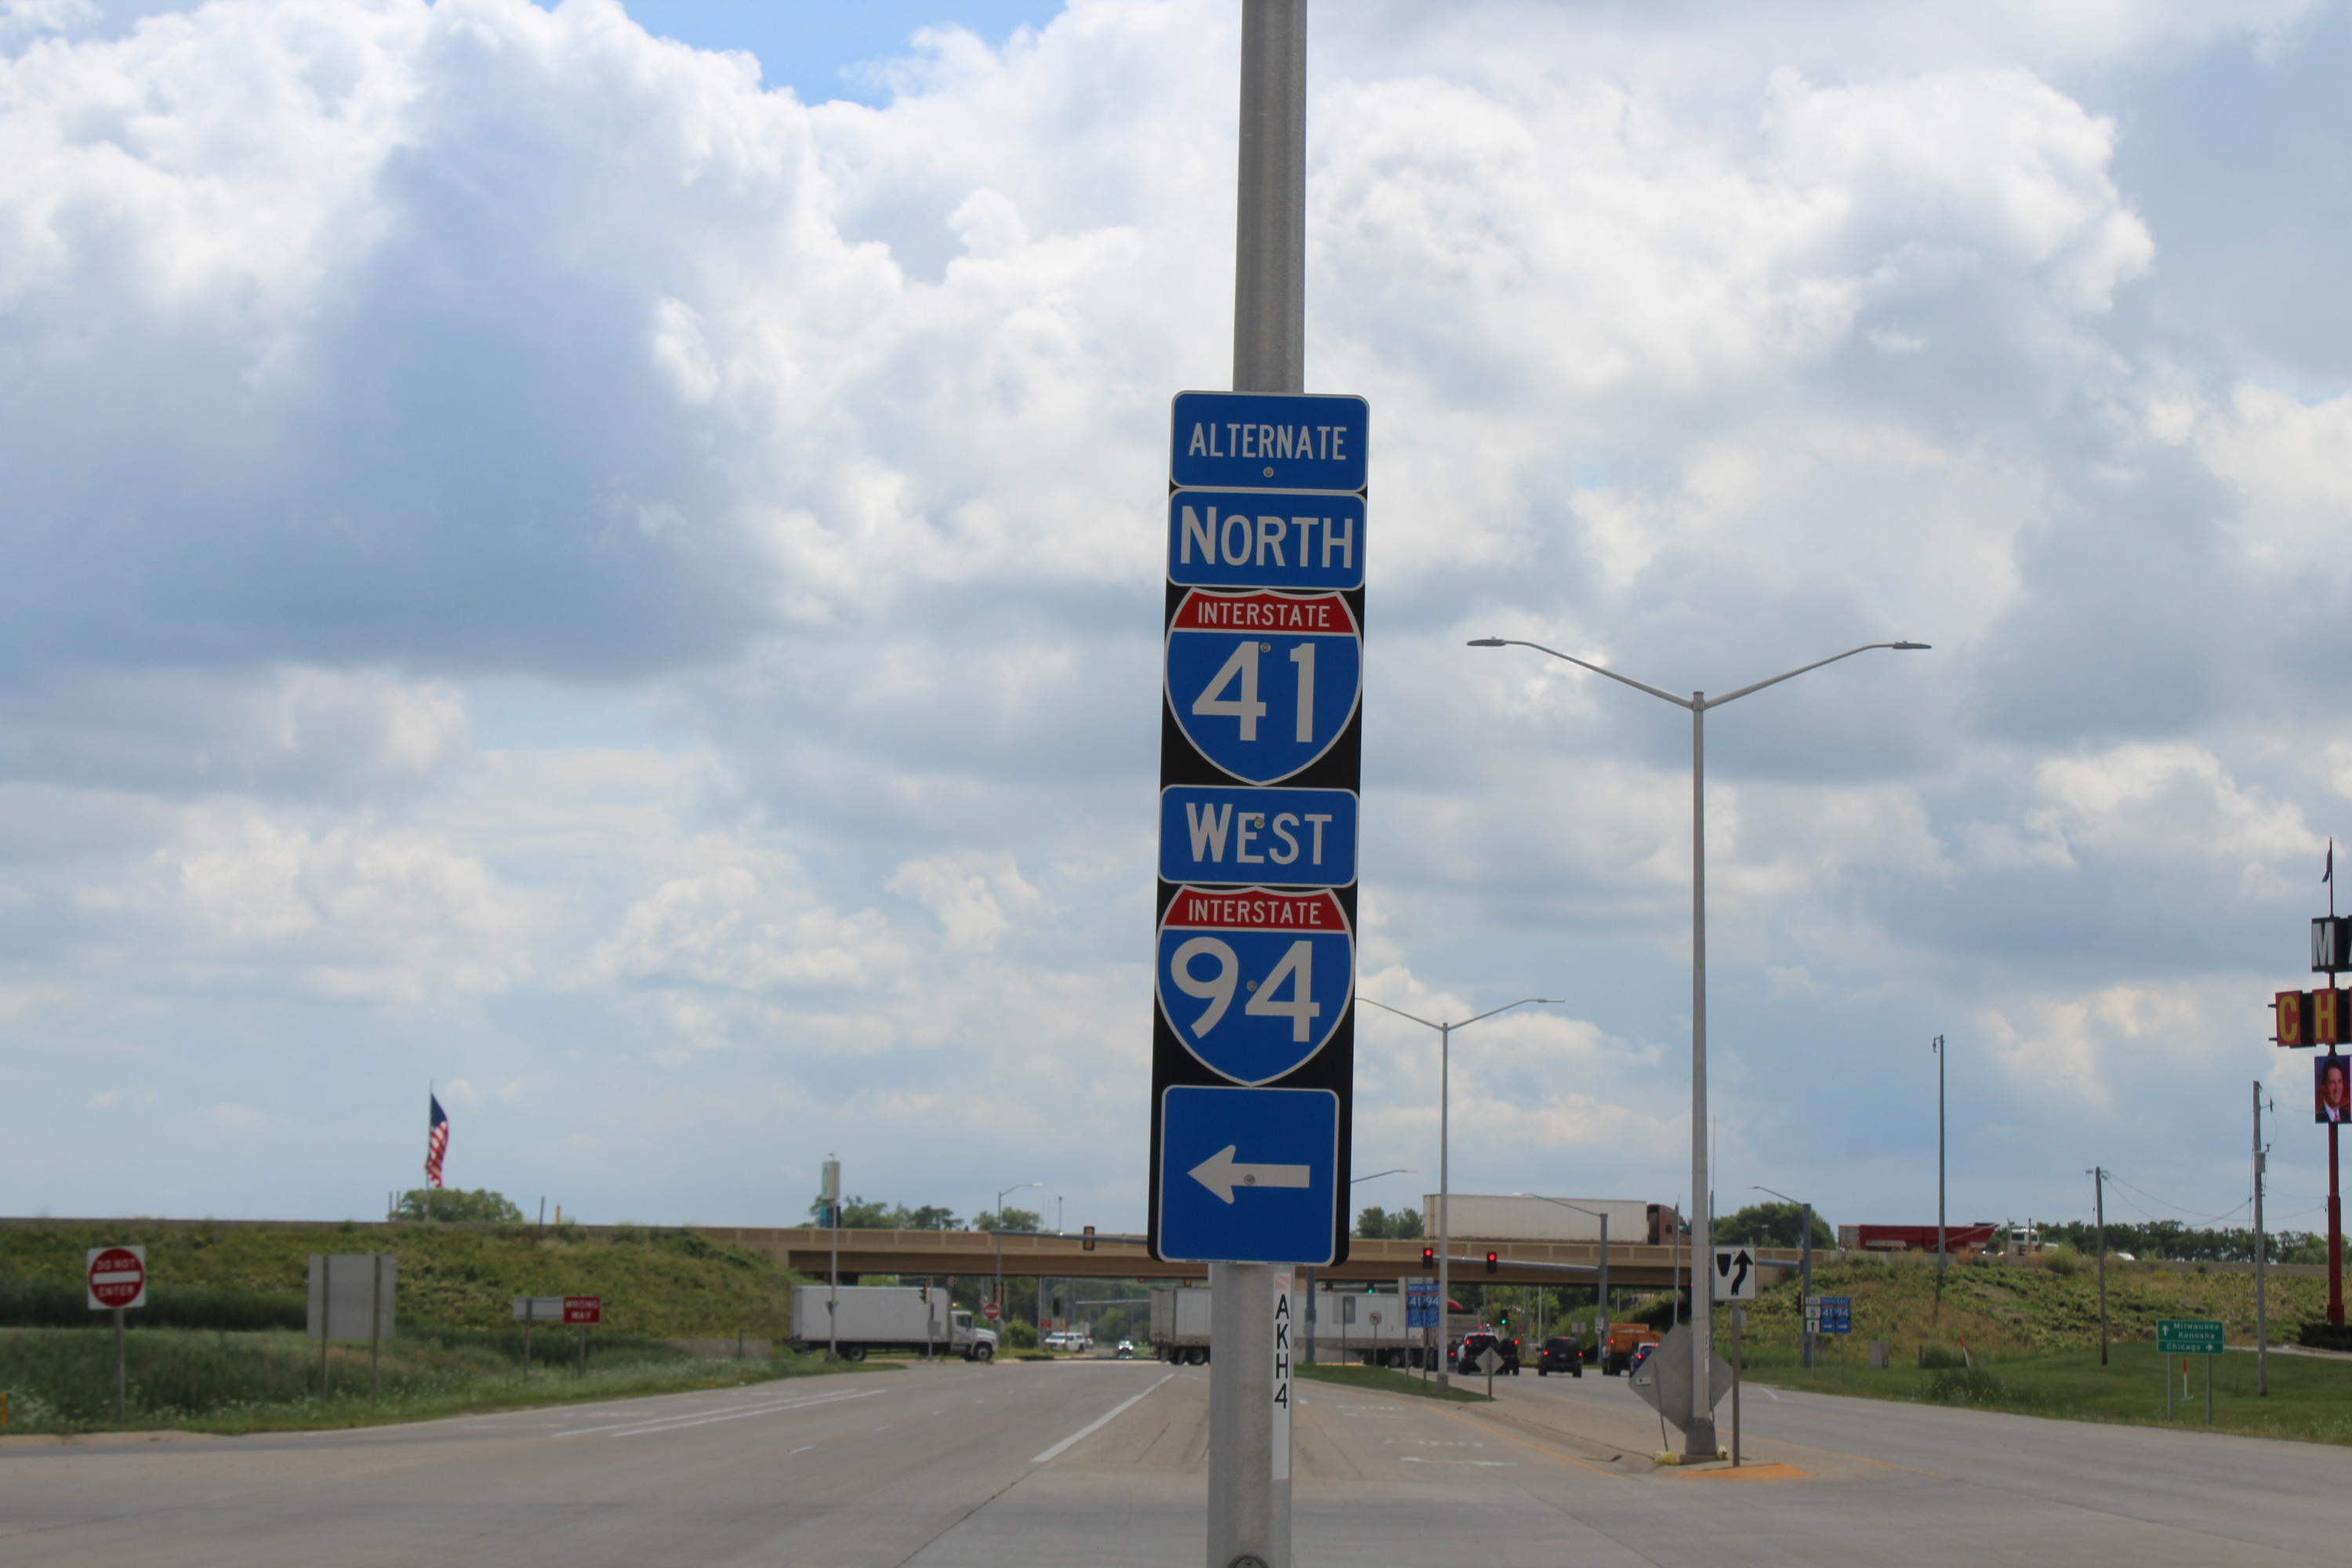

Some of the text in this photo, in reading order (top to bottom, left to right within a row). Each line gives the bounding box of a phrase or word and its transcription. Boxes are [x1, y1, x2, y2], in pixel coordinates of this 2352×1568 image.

[1189, 423, 1348, 461] ALTERNATE
[1180, 506, 1353, 568] NORTH
[1197, 601, 1330, 627] INTERSTATE
[1192, 641, 1316, 742] 41
[1185, 802, 1333, 866] WEST
[1189, 898, 1322, 925] INTERSTATE
[2312, 921, 2352, 967] M
[1171, 936, 1320, 1043] 94
[96, 1258, 136, 1270] DO NOT
[99, 1285, 134, 1298] ENTER
[565, 1300, 598, 1308] WRONG
[1410, 1296, 1421, 1306] 41
[1426, 1296, 1439, 1307] 94
[1822, 1308, 1832, 1317] 41
[1275, 1294, 1290, 1409] AKH4
[2166, 1343, 2201, 1352] Chicago
